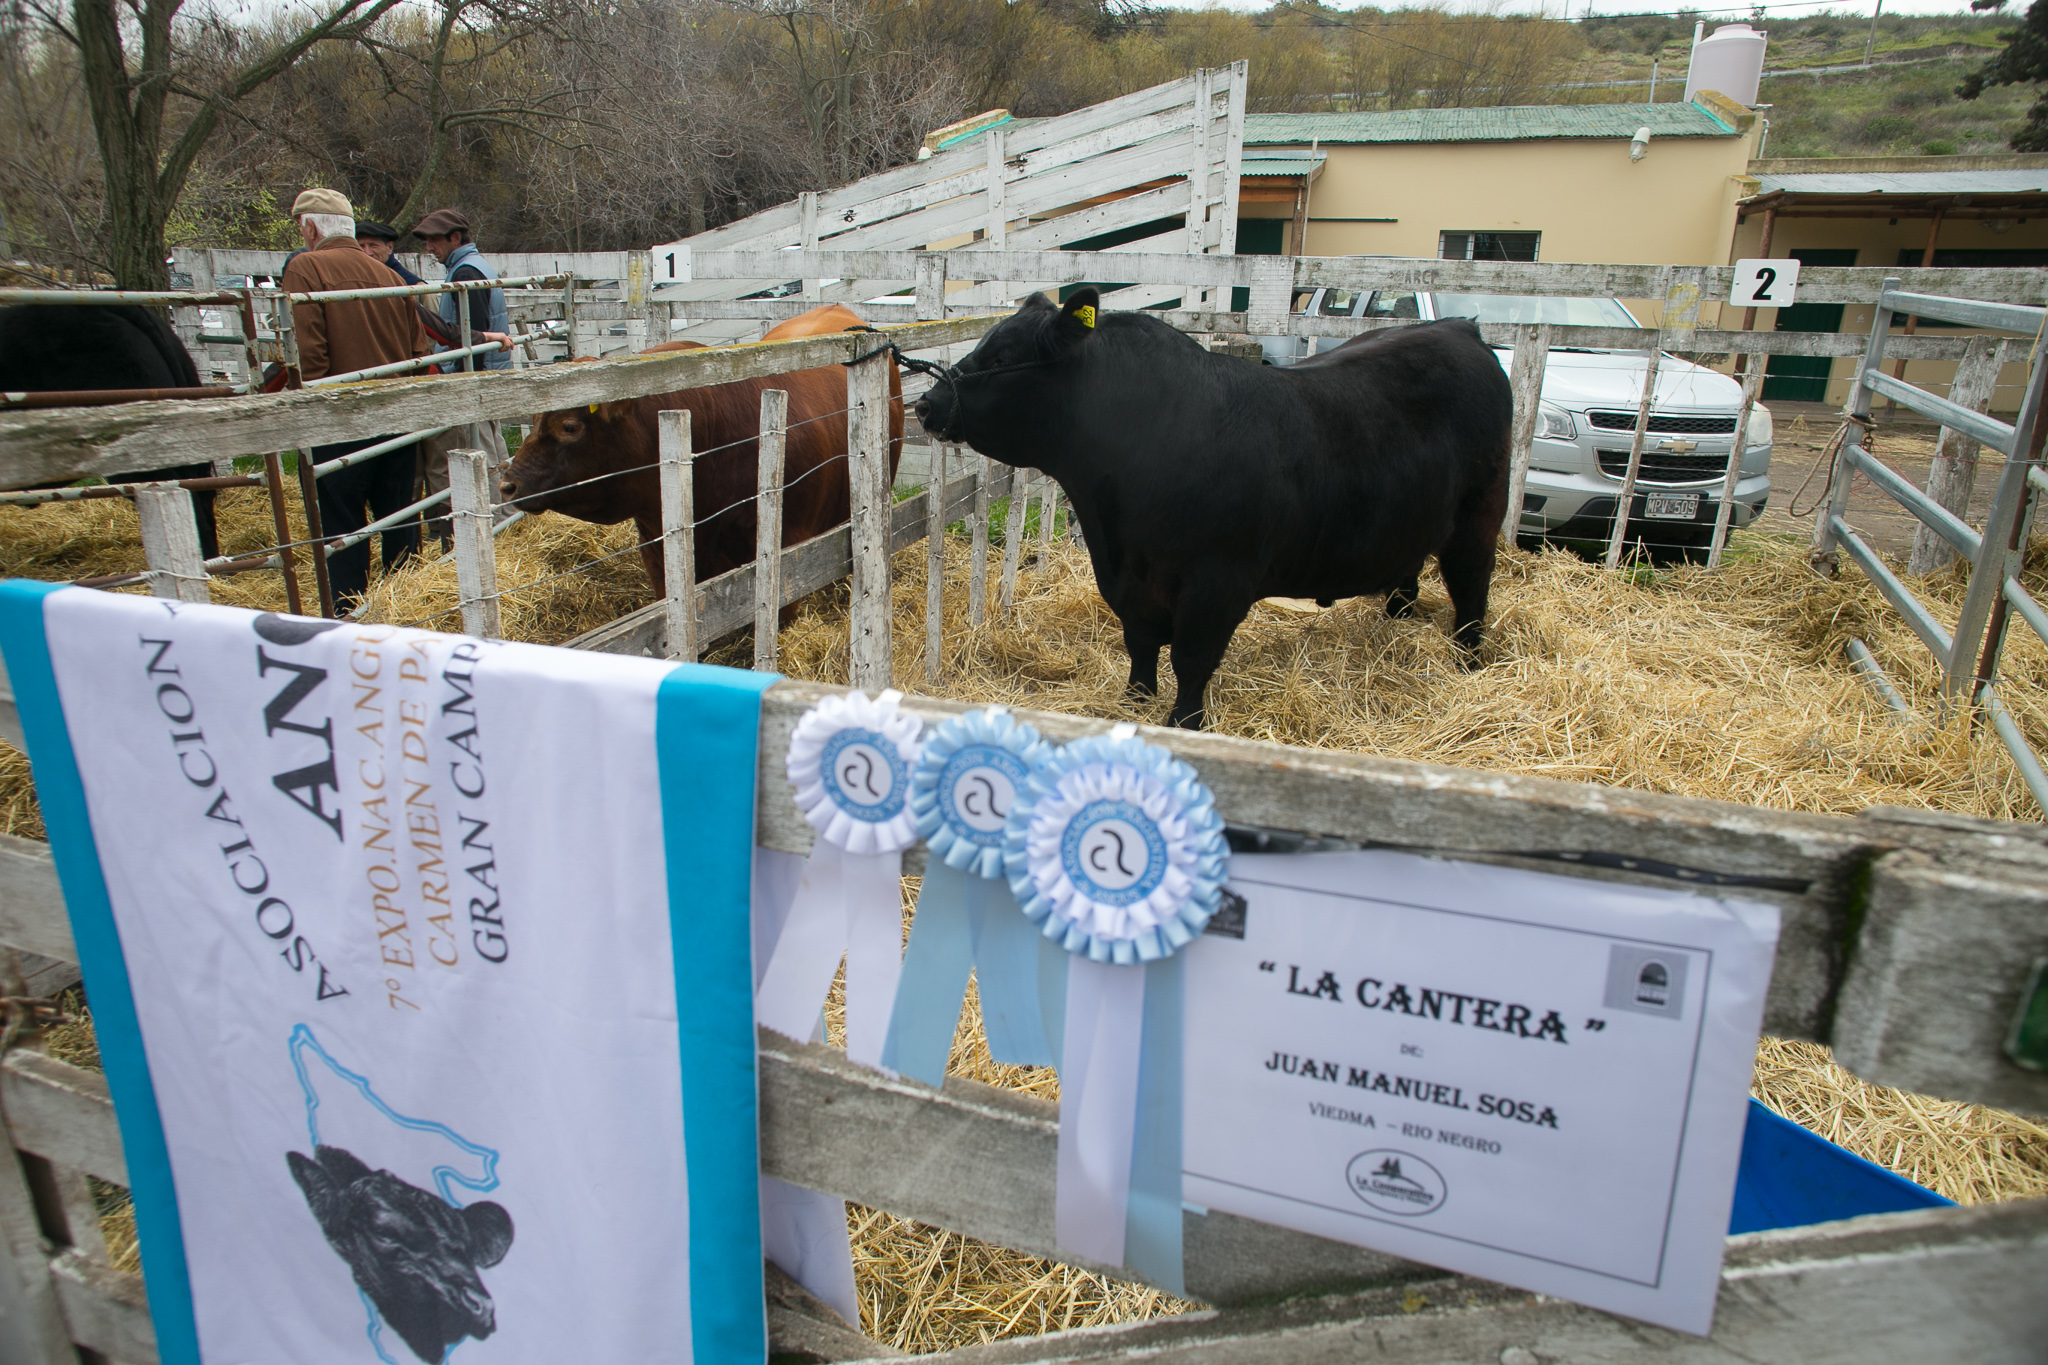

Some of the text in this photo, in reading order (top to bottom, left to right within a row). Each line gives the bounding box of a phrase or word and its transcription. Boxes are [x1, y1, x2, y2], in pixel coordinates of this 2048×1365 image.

[665, 253, 675, 278] 1
[1752, 267, 1777, 301] 2
[1647, 498, 1697, 515] MPV 509
[400, 699, 429, 766] DE
[139, 633, 351, 1001] ASOCIACION
[441, 639, 509, 964] GRAN CAMP
[404, 778, 459, 966] CARMEN
[1286, 964, 1343, 1004] LA
[1356, 977, 1569, 1045] CANTERA
[1265, 1051, 1559, 1130] JUAN MANUEL SOSA
[1308, 1101, 1376, 1129] VIEDMA
[1401, 1121, 1433, 1141] RIO
[1437, 1129, 1503, 1156] NEGRO
